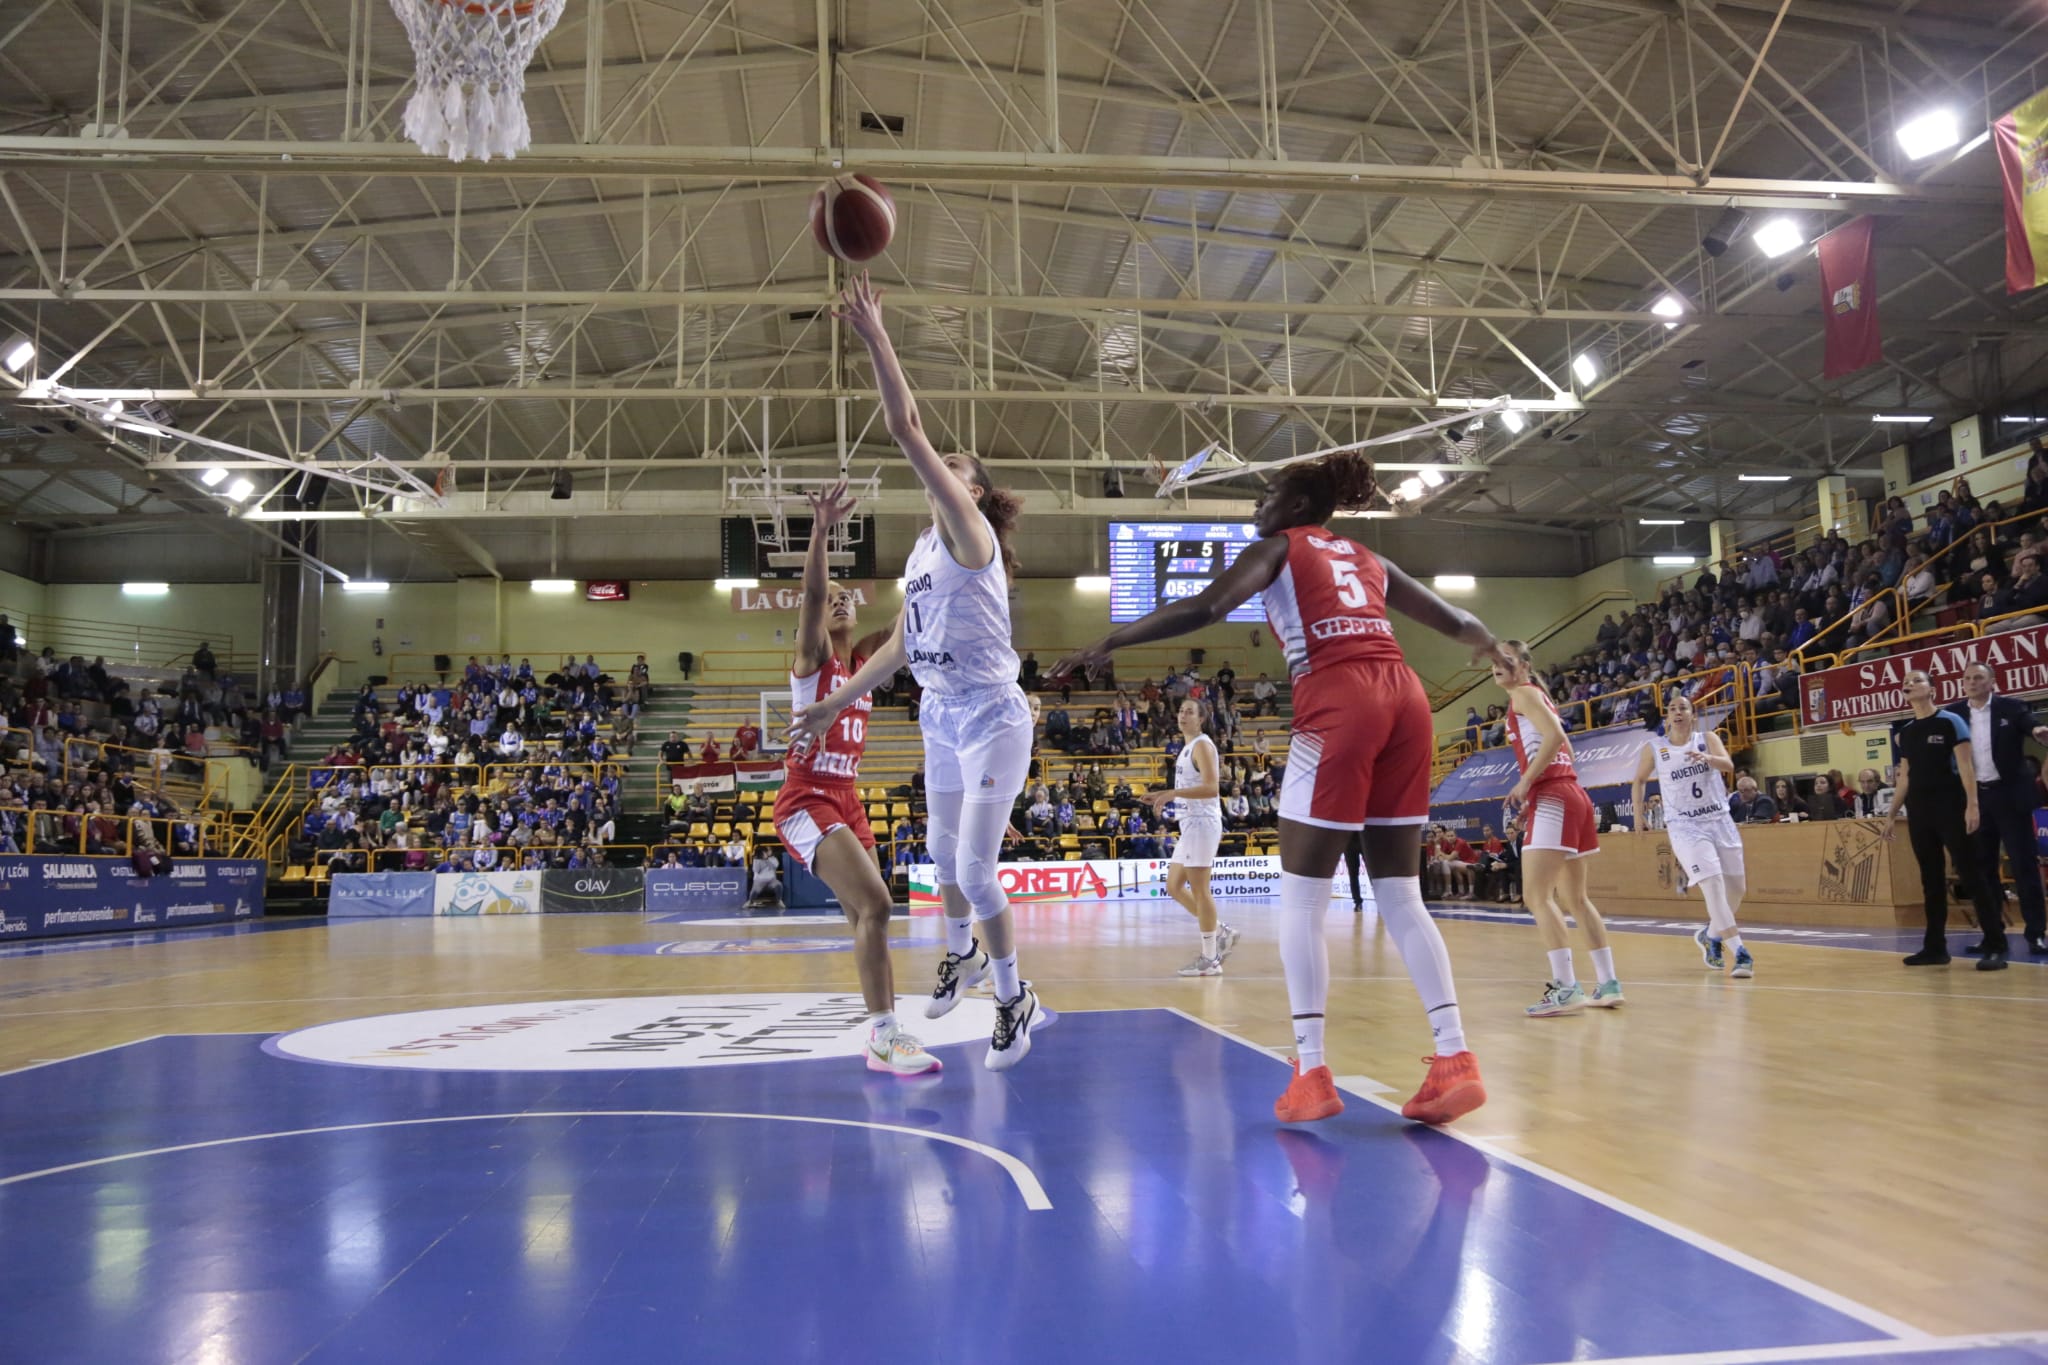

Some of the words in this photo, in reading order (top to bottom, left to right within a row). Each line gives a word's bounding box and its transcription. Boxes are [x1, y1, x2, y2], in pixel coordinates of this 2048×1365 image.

[1161, 541, 1180, 557] 11
[1201, 541, 1214, 557] 5
[1329, 559, 1369, 609] 5
[740, 588, 773, 611] LA
[840, 716, 863, 744] 10
[1671, 762, 1709, 781] AVENIDA
[1692, 782, 1703, 799] 6
[8, 863, 29, 878] LEÓN
[43, 864, 97, 878] SALAMANCA
[337, 887, 426, 899] MAYBELLINE
[1225, 886, 1270, 895] Urbano
